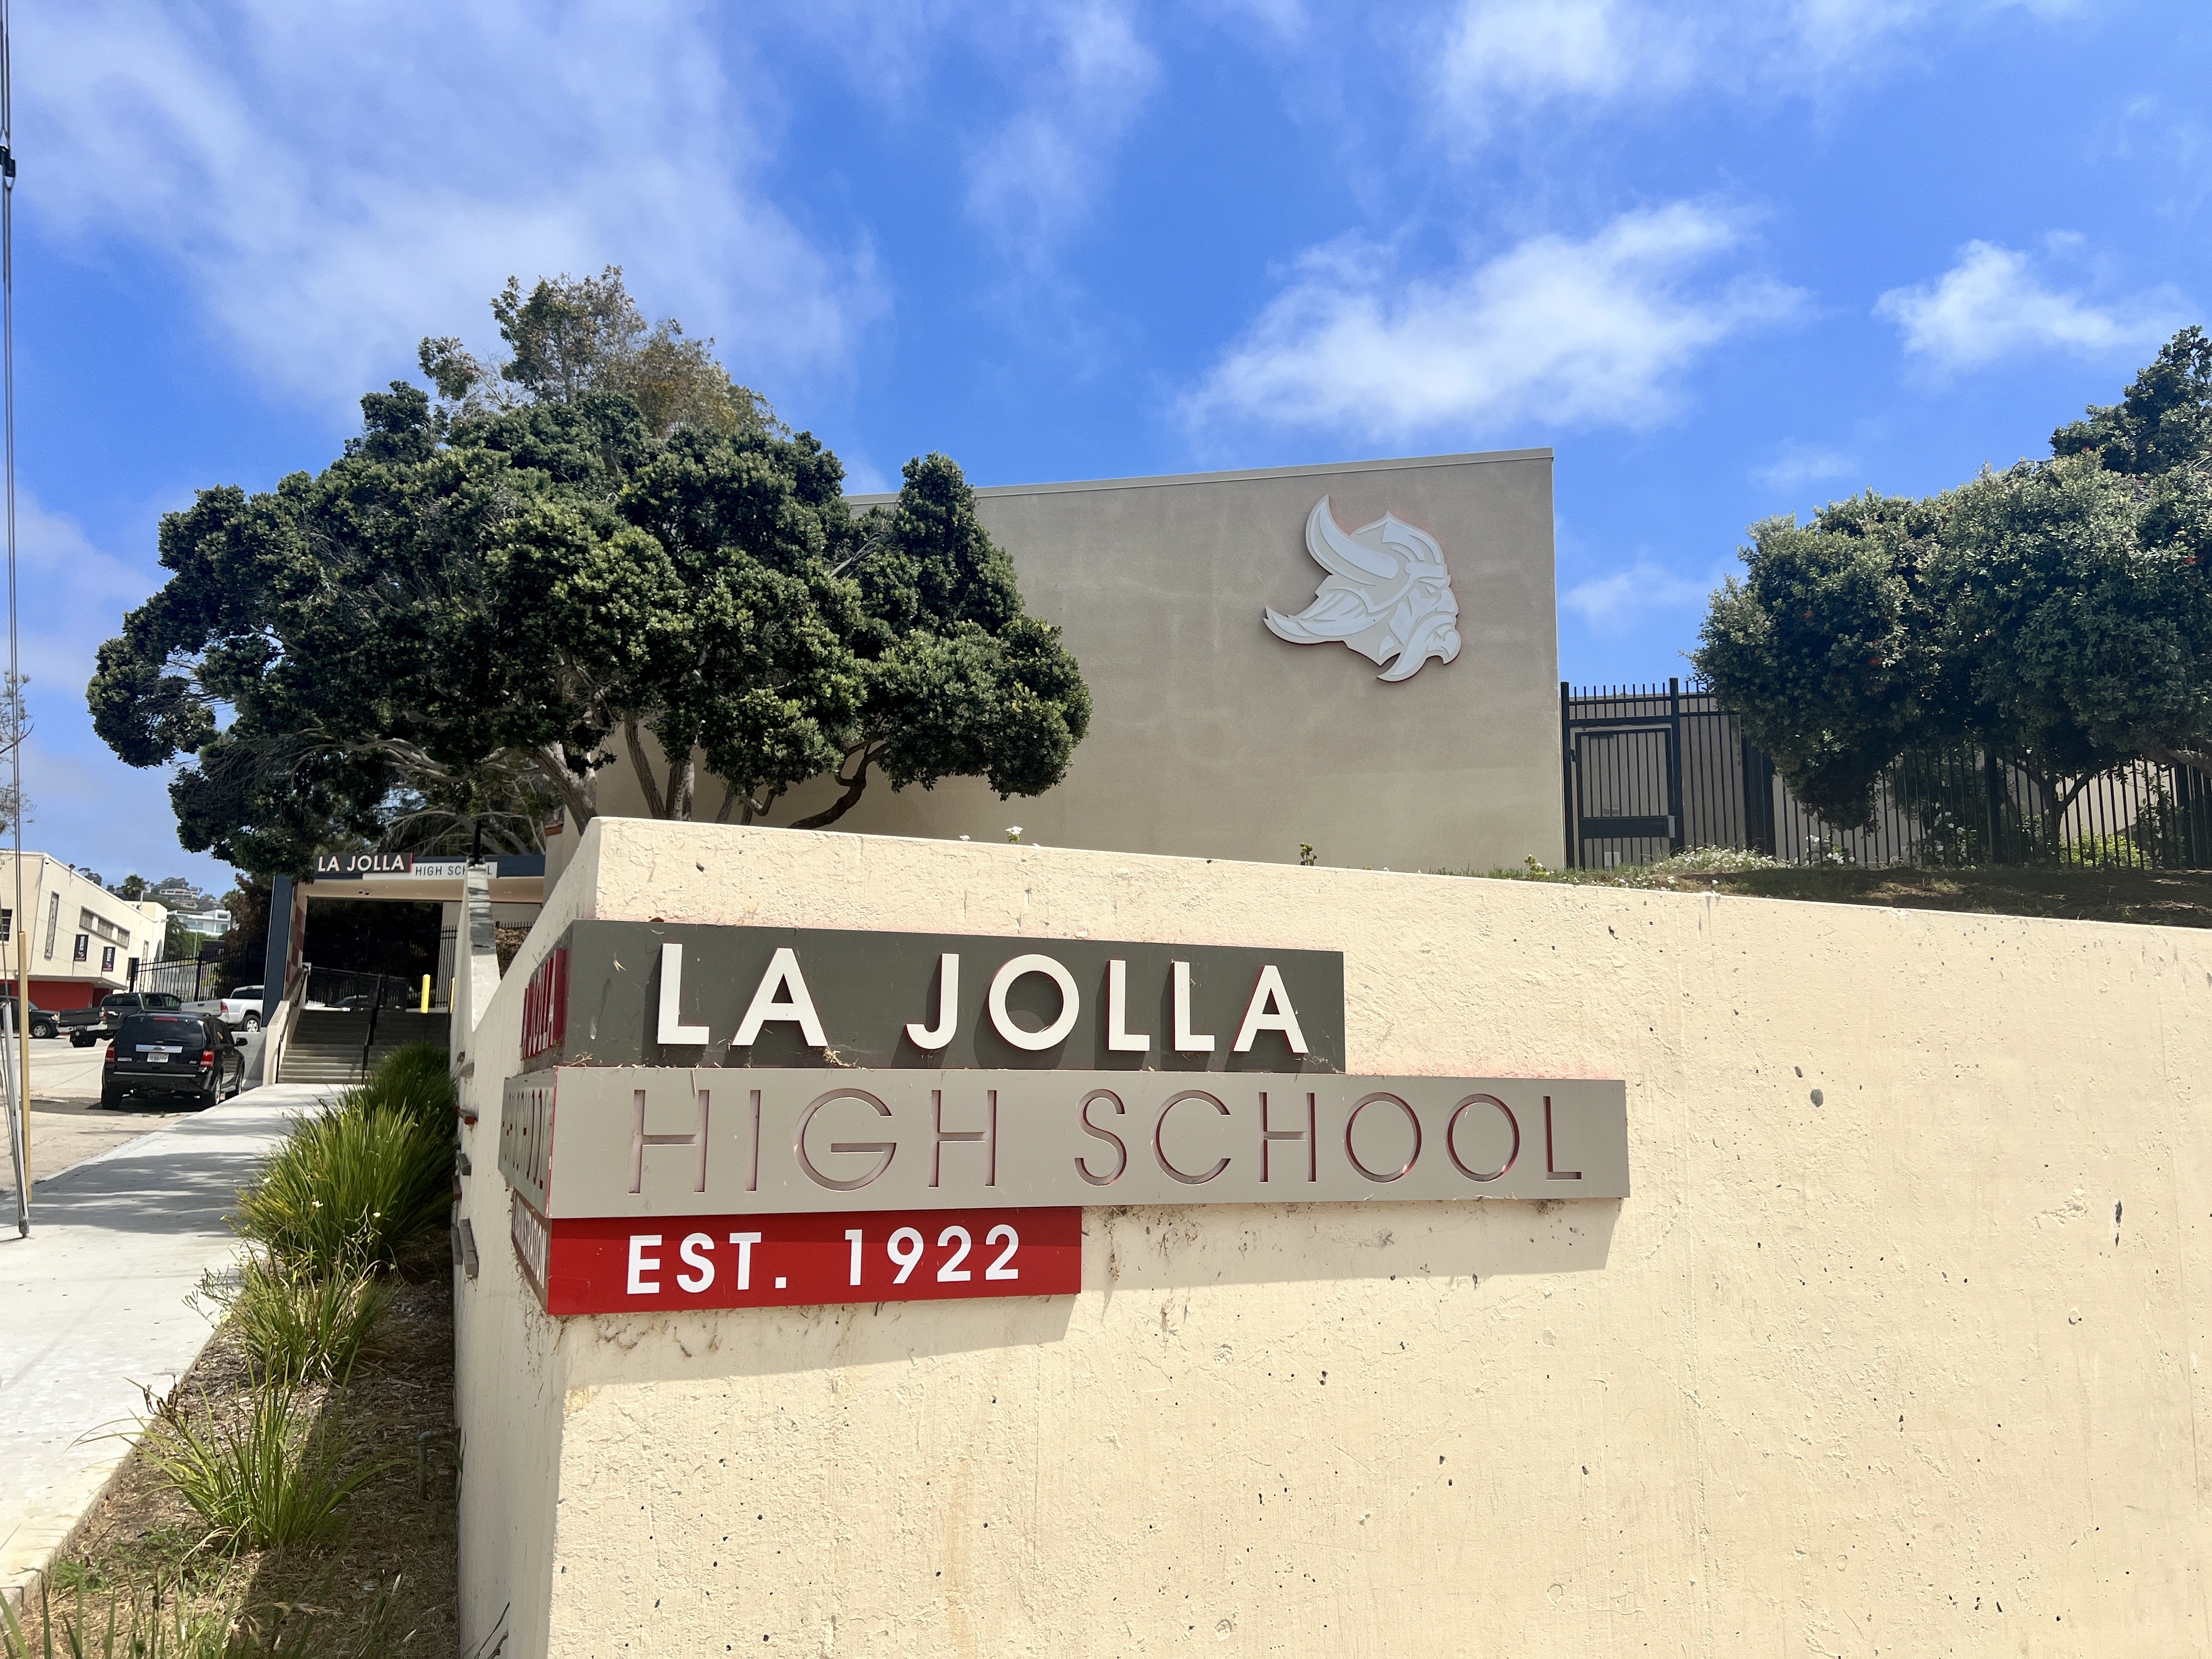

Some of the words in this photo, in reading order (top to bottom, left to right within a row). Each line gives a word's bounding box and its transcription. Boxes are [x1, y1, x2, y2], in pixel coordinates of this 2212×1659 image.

[318, 855, 340, 872] LA
[347, 854, 405, 872] JOLLA
[415, 865, 442, 876] HIGH
[448, 865, 492, 876] SCL
[657, 943, 827, 1047] LA
[906, 953, 1309, 1054] JOLLA
[627, 1088, 997, 1194] HIGH
[1074, 1088, 1582, 1186] SCHOOL
[627, 1232, 787, 1295] EST.
[844, 1224, 1020, 1286] 1922
